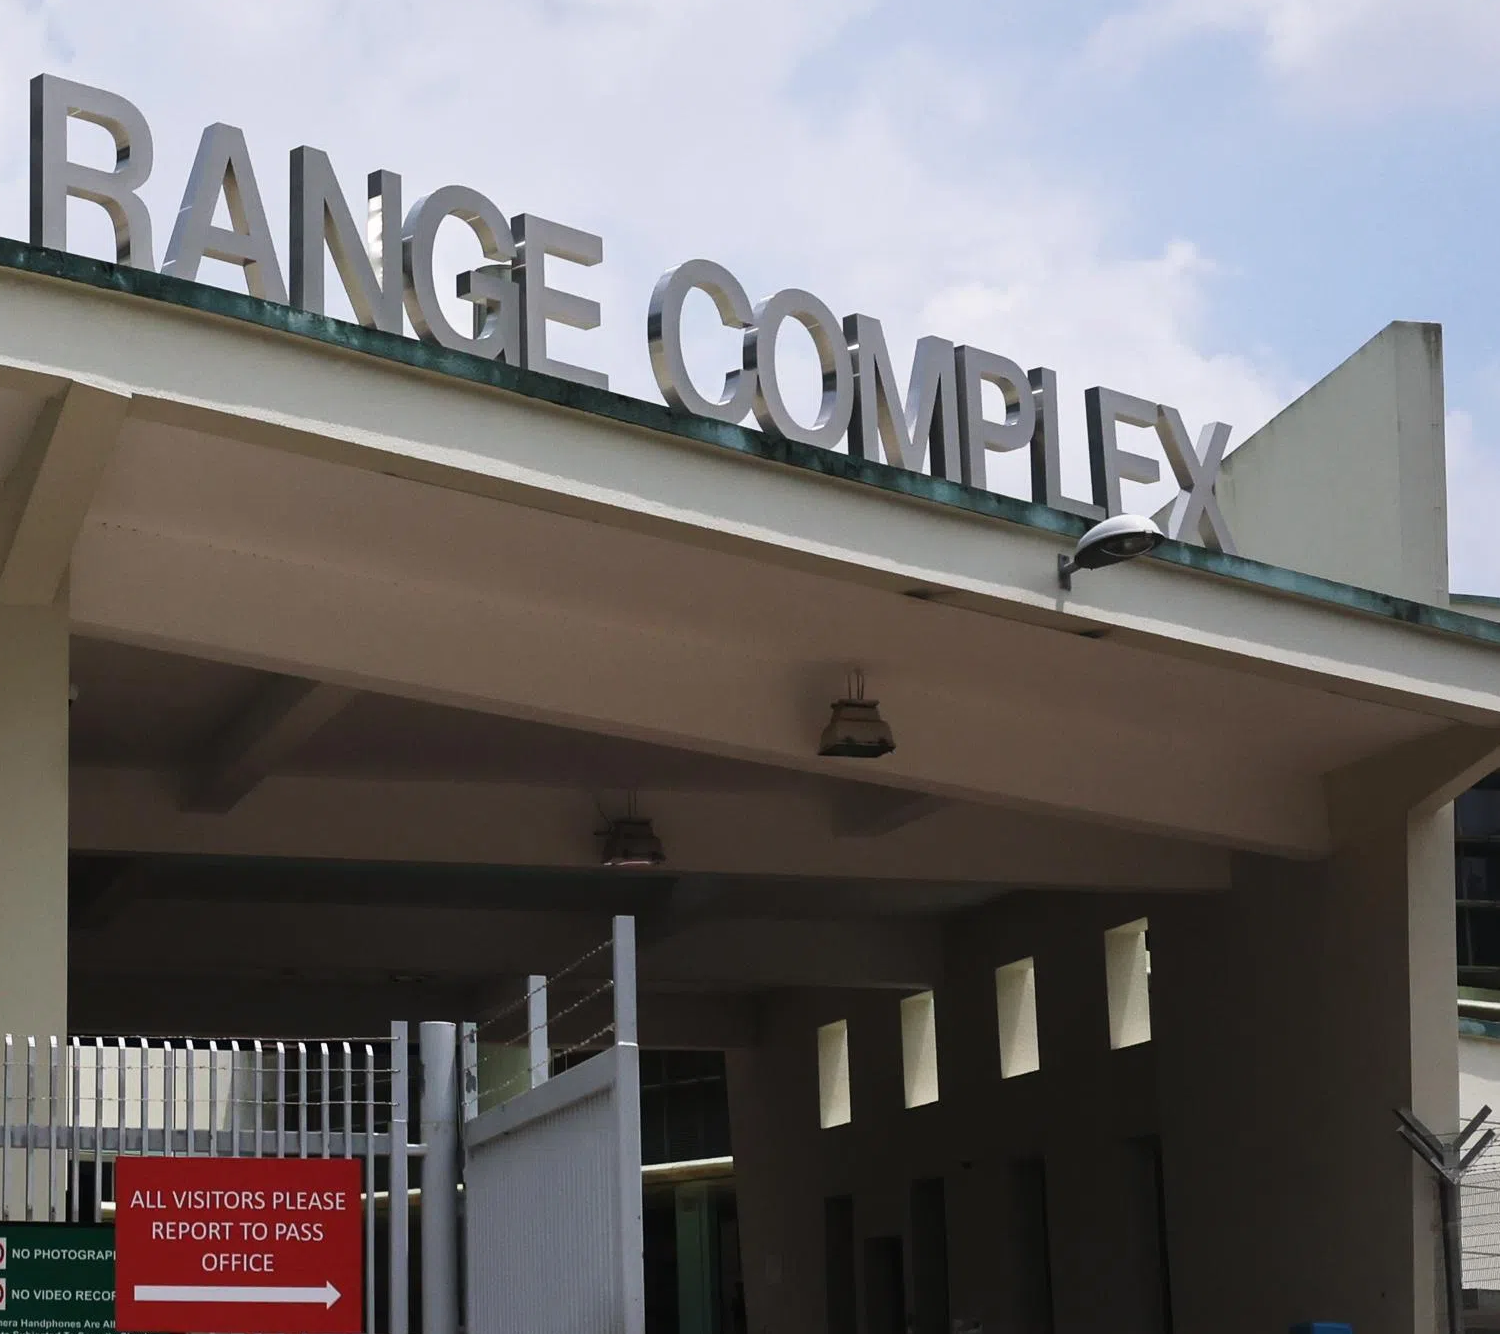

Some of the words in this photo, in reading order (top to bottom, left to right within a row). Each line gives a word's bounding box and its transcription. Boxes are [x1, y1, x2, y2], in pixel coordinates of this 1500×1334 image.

[29, 72, 609, 391] RANGE
[647, 258, 1240, 557] COMPLEX
[130, 1190, 166, 1209] ALL
[172, 1190, 265, 1210] VISITORS
[272, 1191, 346, 1211] PLEASE
[152, 1222, 234, 1240] REPORT
[239, 1223, 268, 1241] TO
[275, 1223, 324, 1241] PASS
[12, 1248, 31, 1259] NO
[34, 1249, 116, 1261] PHOTOGRAP
[201, 1253, 274, 1272] OFFICE
[12, 1289, 30, 1300] NO
[34, 1289, 72, 1301] VIDEO
[20, 1318, 81, 1330] Handphones
[84, 1319, 101, 1329] Are
